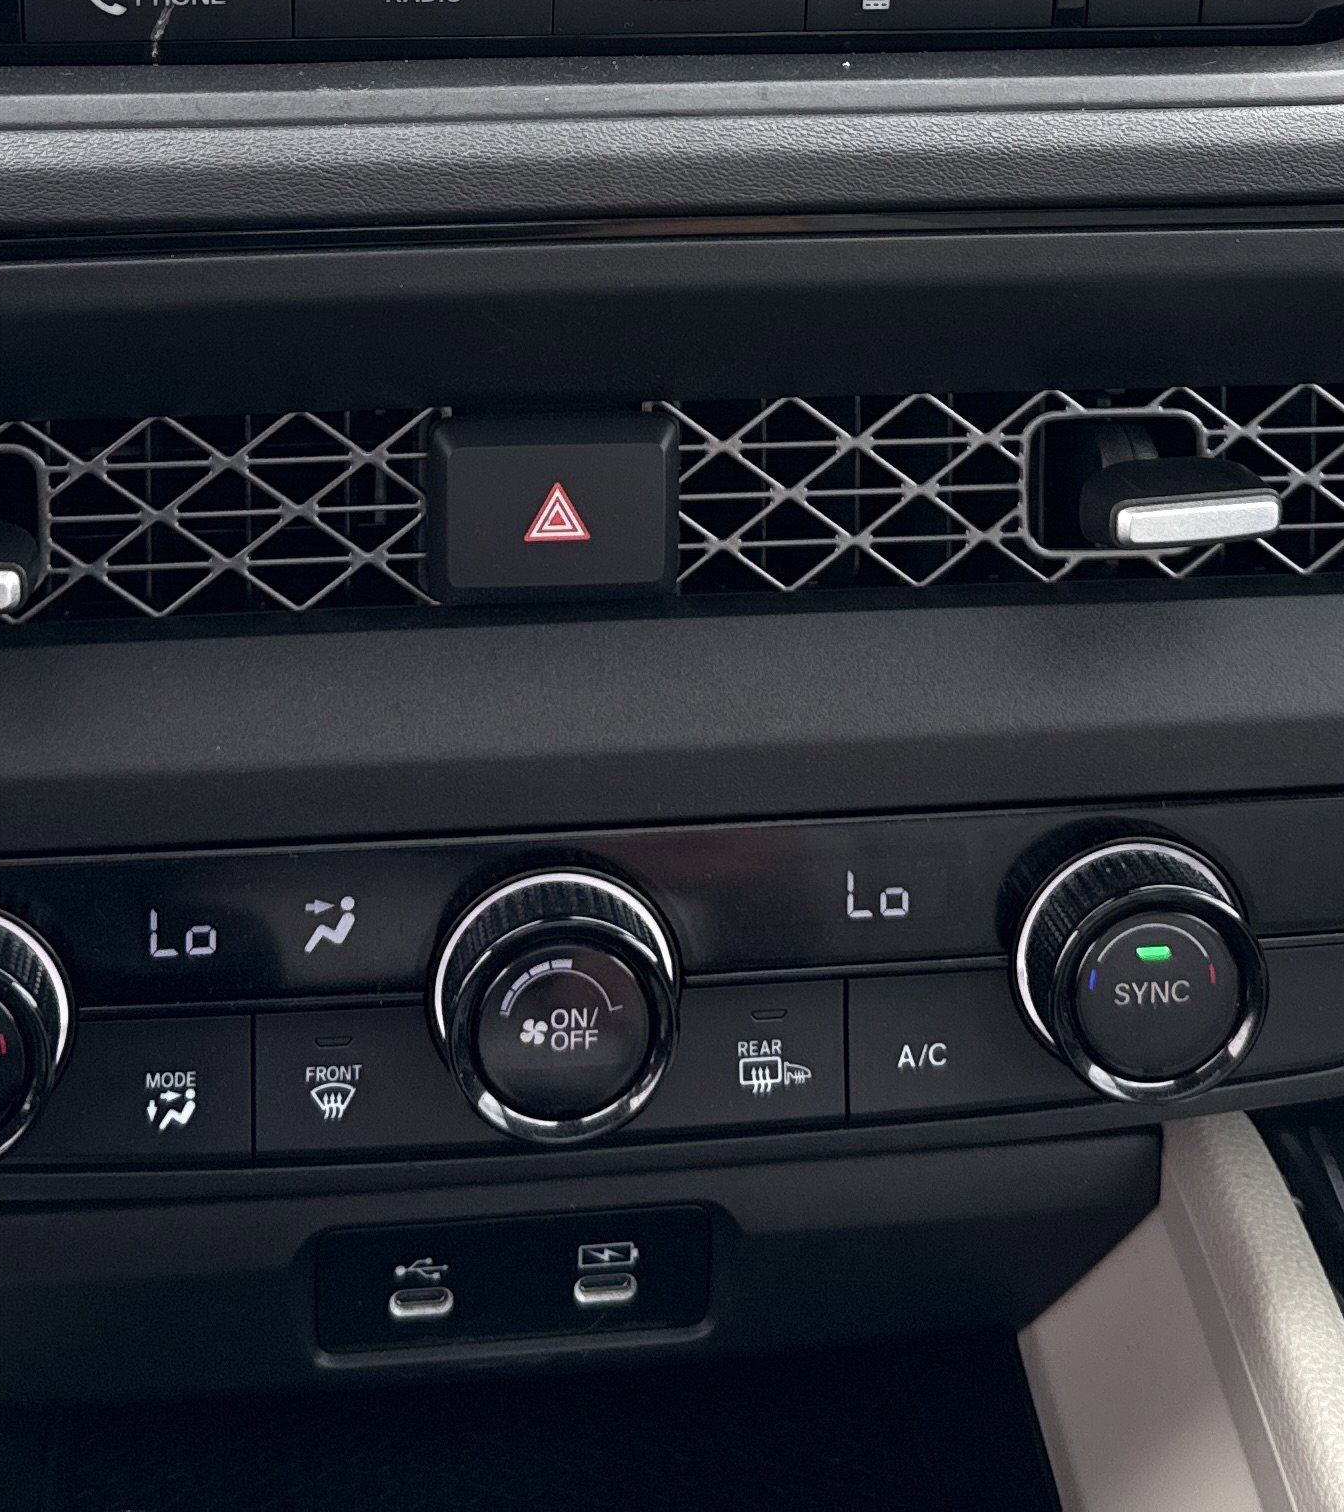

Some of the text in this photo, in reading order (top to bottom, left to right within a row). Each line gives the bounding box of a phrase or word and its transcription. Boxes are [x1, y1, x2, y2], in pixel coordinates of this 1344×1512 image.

[846, 870, 910, 919] Lo
[149, 908, 217, 958] Lo
[1114, 979, 1191, 1007] SYNC
[550, 1007, 599, 1031] ON/
[550, 1029, 599, 1052] OFF
[737, 1039, 782, 1058] REAR
[897, 1043, 947, 1069] A/C
[145, 1071, 197, 1089] MODE
[304, 1064, 362, 1083] FRONT
